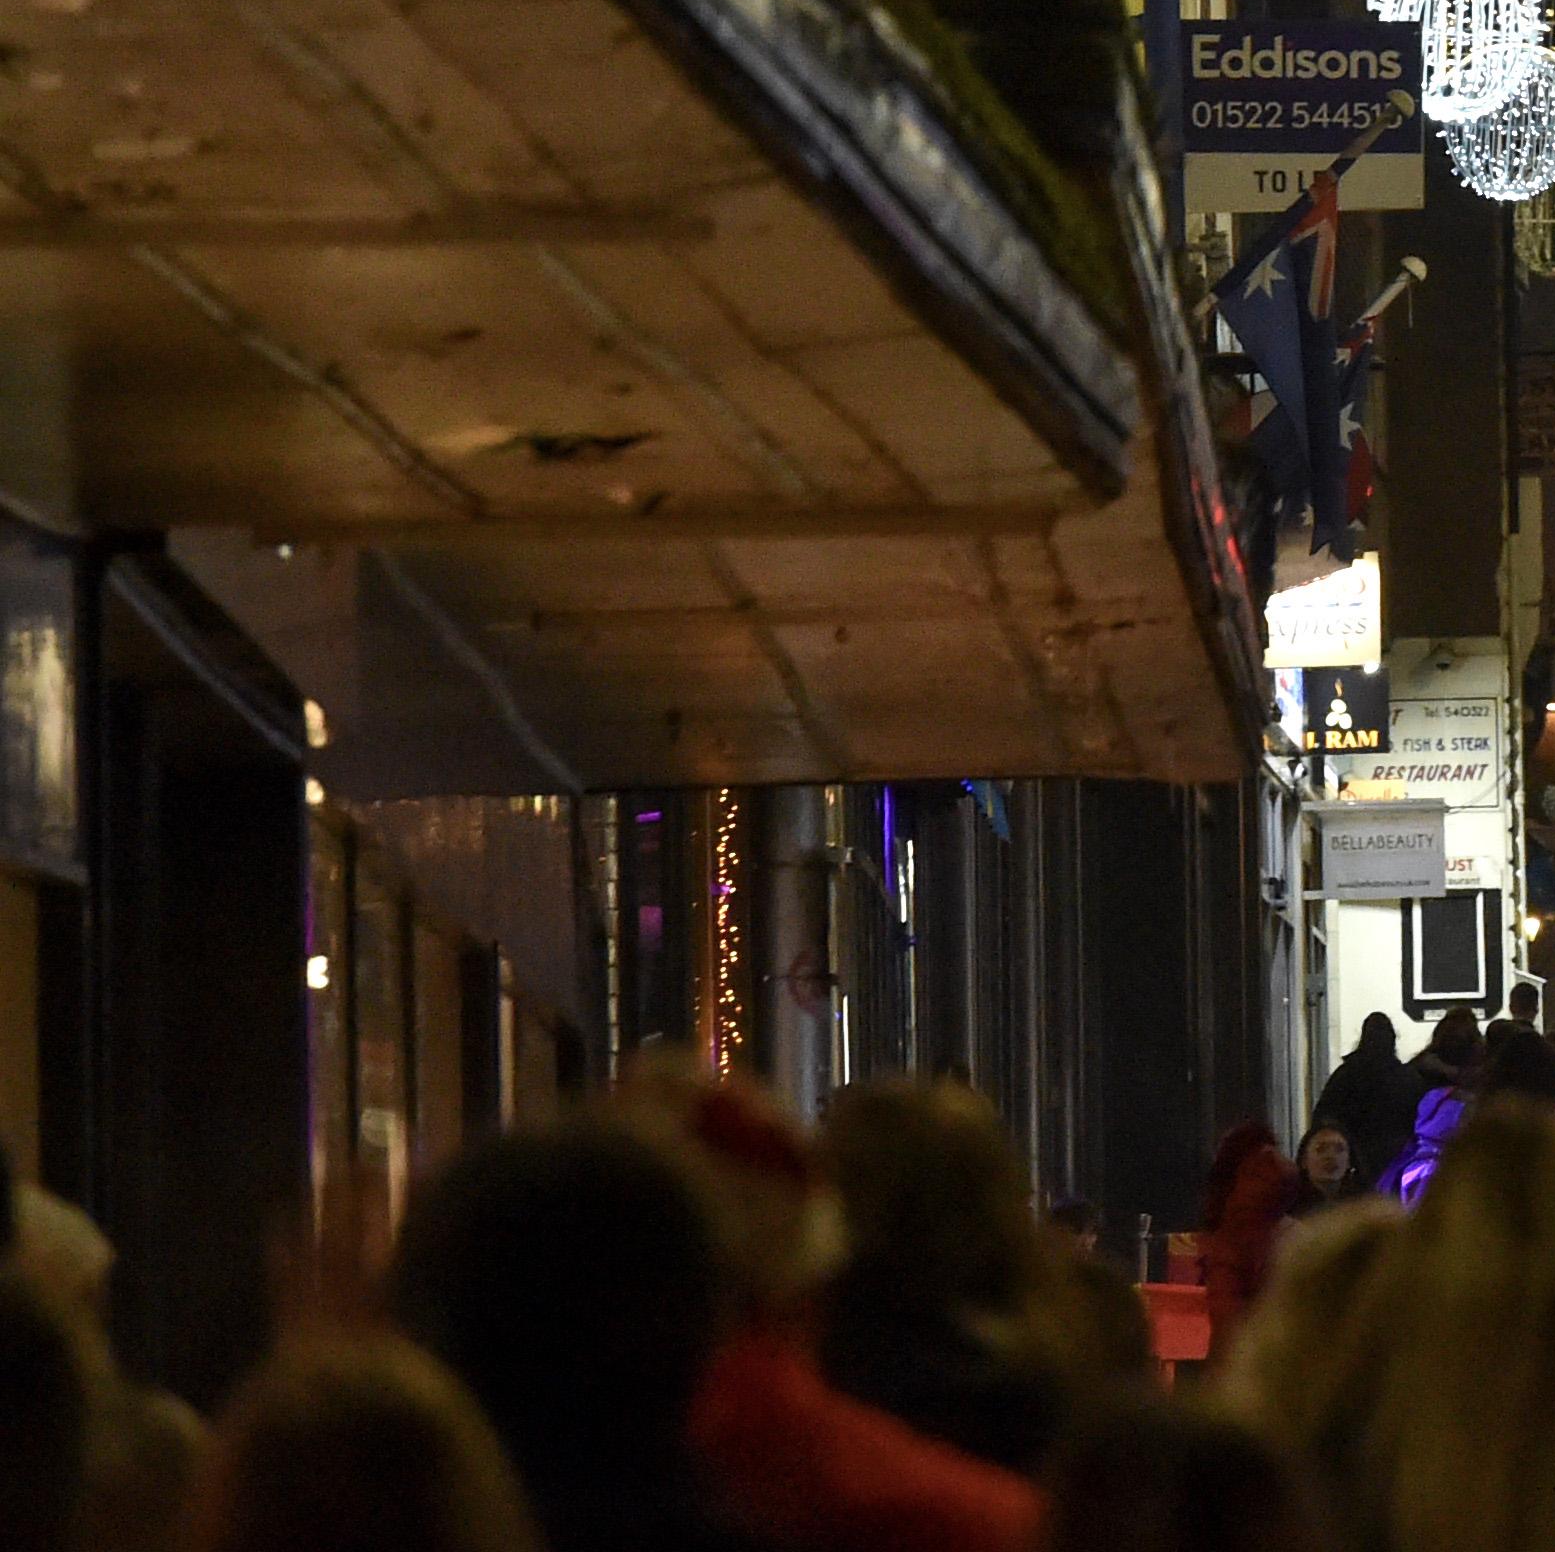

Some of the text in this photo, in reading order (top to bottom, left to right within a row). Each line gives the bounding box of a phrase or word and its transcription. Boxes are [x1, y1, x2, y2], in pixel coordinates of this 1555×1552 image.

[1191, 34, 1403, 80] Eddisons
[1192, 100, 1283, 129] 01522
[1253, 170, 1287, 193] TO
[1325, 729, 1379, 749] RAM
[1402, 738, 1431, 752] FISH
[1435, 739, 1446, 751] &
[1451, 737, 1490, 751] STEAK
[1371, 763, 1489, 783] RESTAURANT
[1331, 834, 1434, 851] BELLABEAUTY
[1444, 858, 1474, 872] UST
